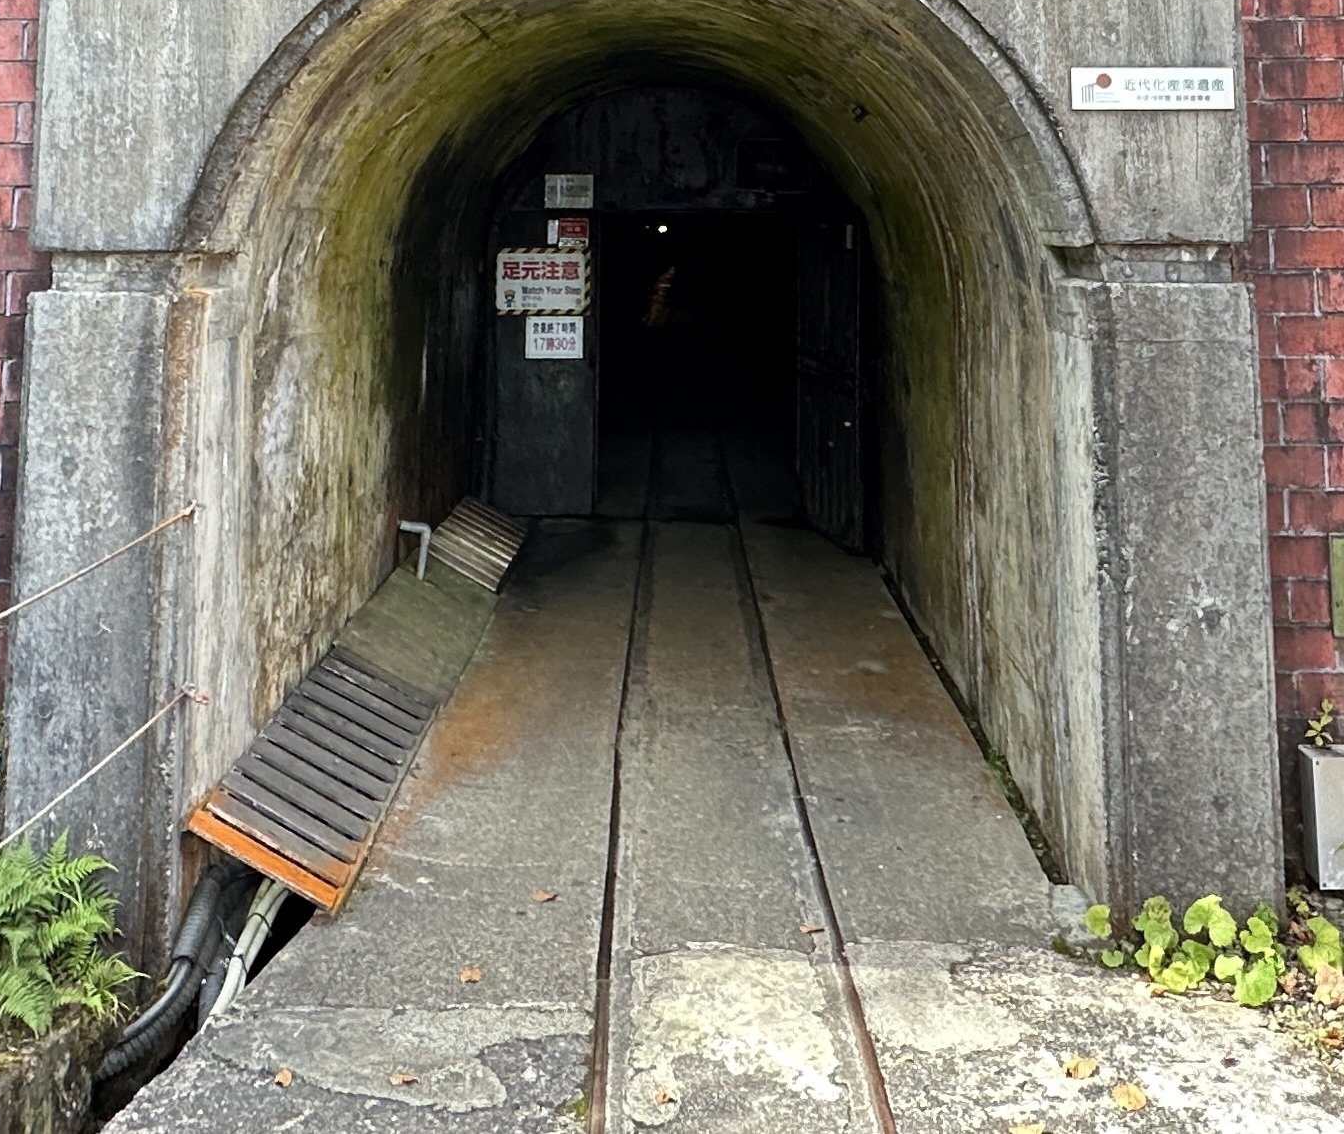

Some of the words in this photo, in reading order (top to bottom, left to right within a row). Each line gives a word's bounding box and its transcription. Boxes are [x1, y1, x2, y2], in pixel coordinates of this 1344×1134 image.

[1124, 79, 1224, 92] 近代化産業遺産
[502, 261, 580, 281] 足元注意
[521, 286, 544, 295] Watch
[546, 286, 563, 295] Your
[564, 286, 582, 296] Step
